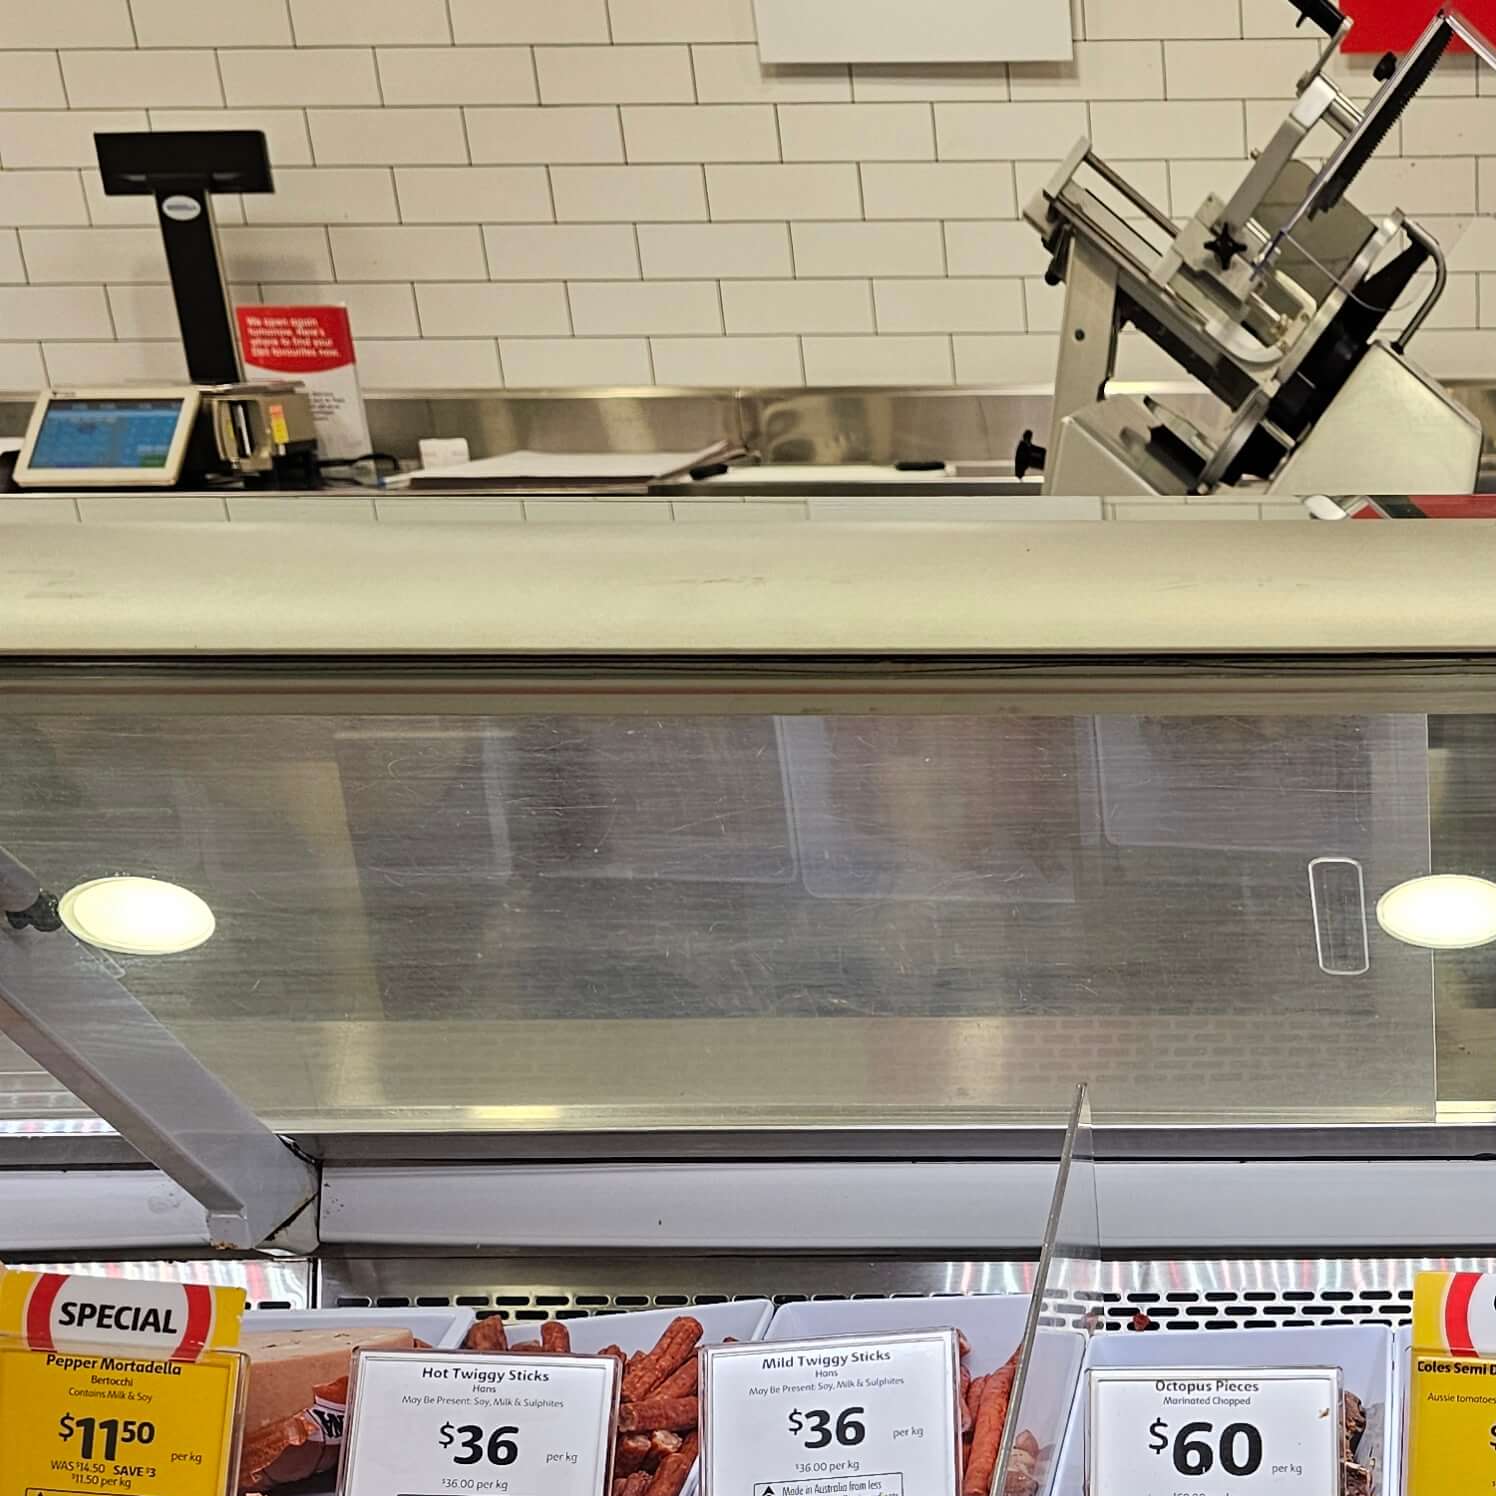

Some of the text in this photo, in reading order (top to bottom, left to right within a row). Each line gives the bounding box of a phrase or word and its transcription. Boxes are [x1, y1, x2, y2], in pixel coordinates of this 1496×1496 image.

[59, 1302, 178, 1334] SPECIAL
[46, 1354, 182, 1376] Pepper Mortadella
[762, 1350, 891, 1369] Mild Twiggy Sticks
[815, 1369, 838, 1378] Hans
[1418, 1362, 1451, 1373] Coles
[1454, 1362, 1487, 1374] Semi
[422, 1367, 550, 1383] Hot Twiggy Sticks
[91, 1376, 133, 1387] Bertocchi
[1155, 1380, 1259, 1394] Octopus Pieces
[472, 1384, 496, 1394] Hans
[1163, 1396, 1251, 1406] Marinated Chopped
[788, 1407, 865, 1449] $36
[893, 1427, 924, 1439] per kg
[438, 1421, 519, 1466] $36
[1149, 1417, 1263, 1476] $60
[171, 1453, 202, 1464] per kg
[546, 1452, 578, 1464] per kg
[1272, 1464, 1302, 1475] per kg
